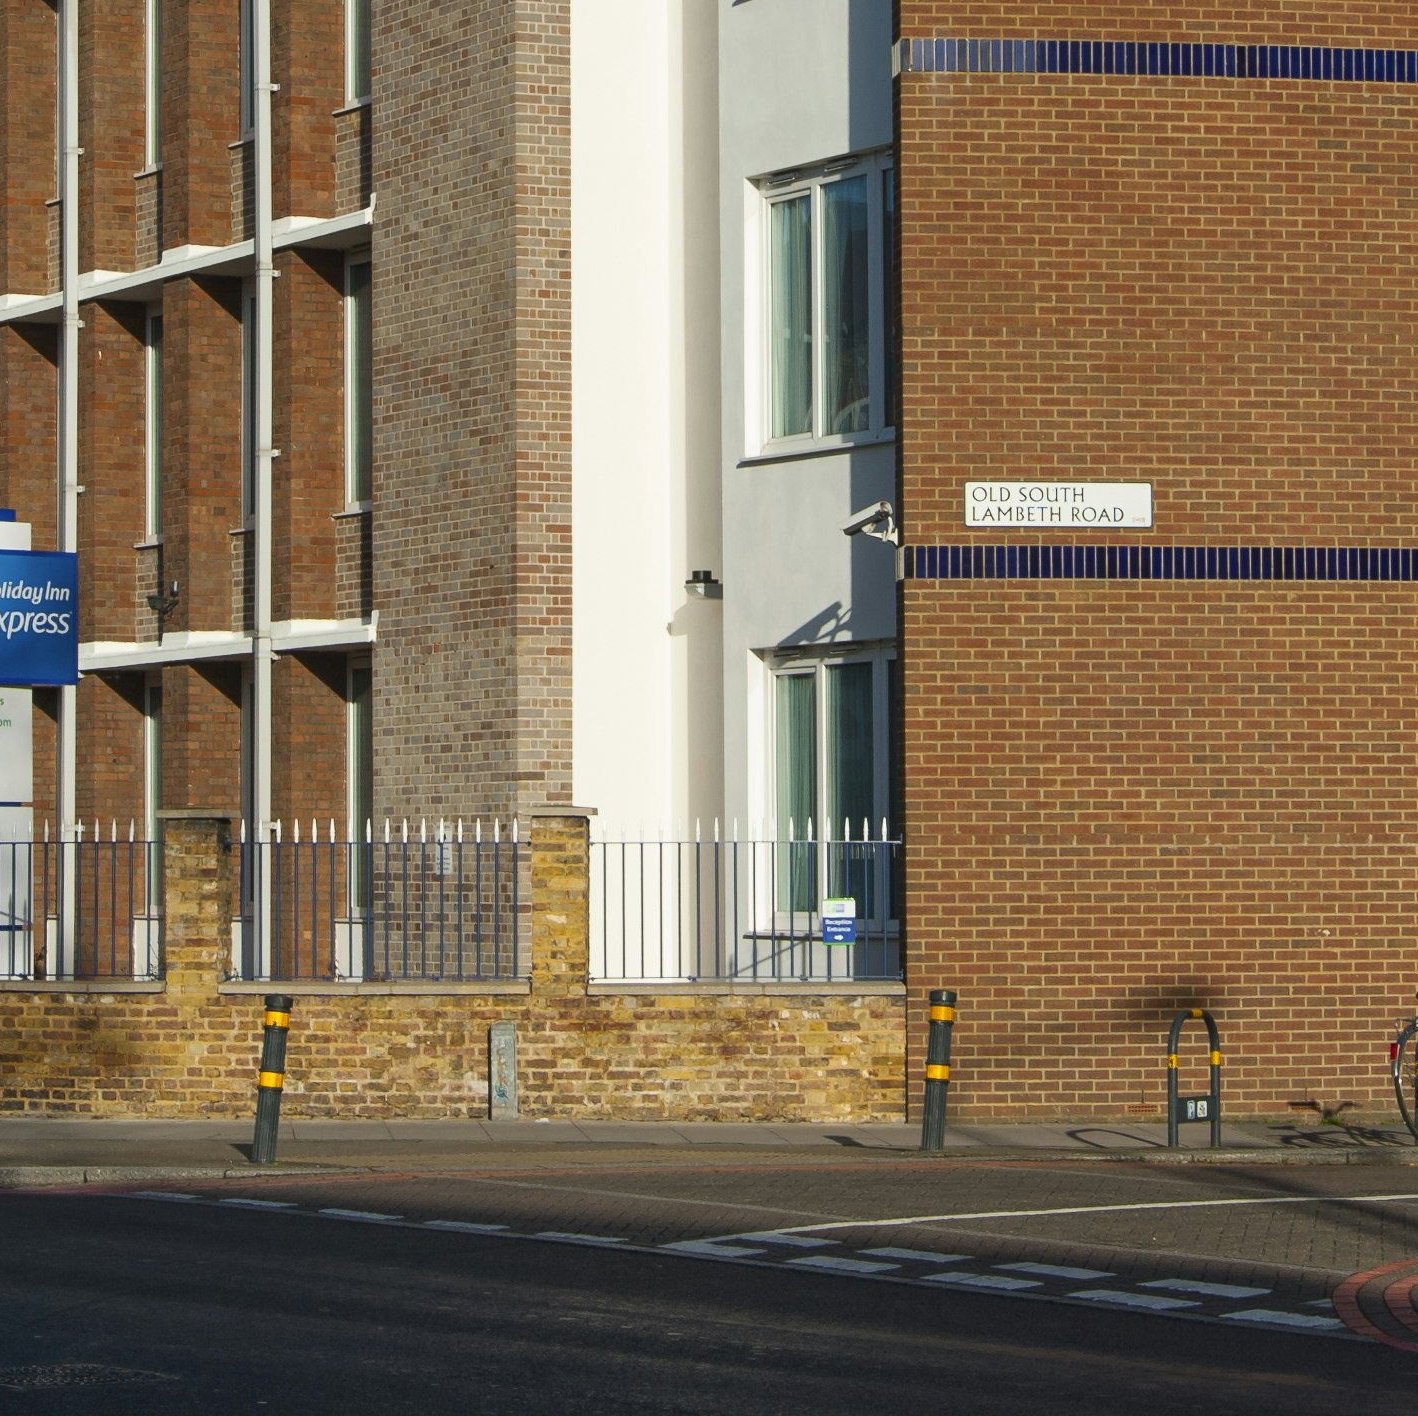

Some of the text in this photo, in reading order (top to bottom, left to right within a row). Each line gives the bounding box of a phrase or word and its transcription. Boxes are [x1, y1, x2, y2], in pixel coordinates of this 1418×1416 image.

[972, 486, 1085, 503] OLD SOUTH
[972, 506, 1061, 522] LAMBETH
[1071, 506, 1124, 523] ROAD
[44, 580, 70, 601] Inn
